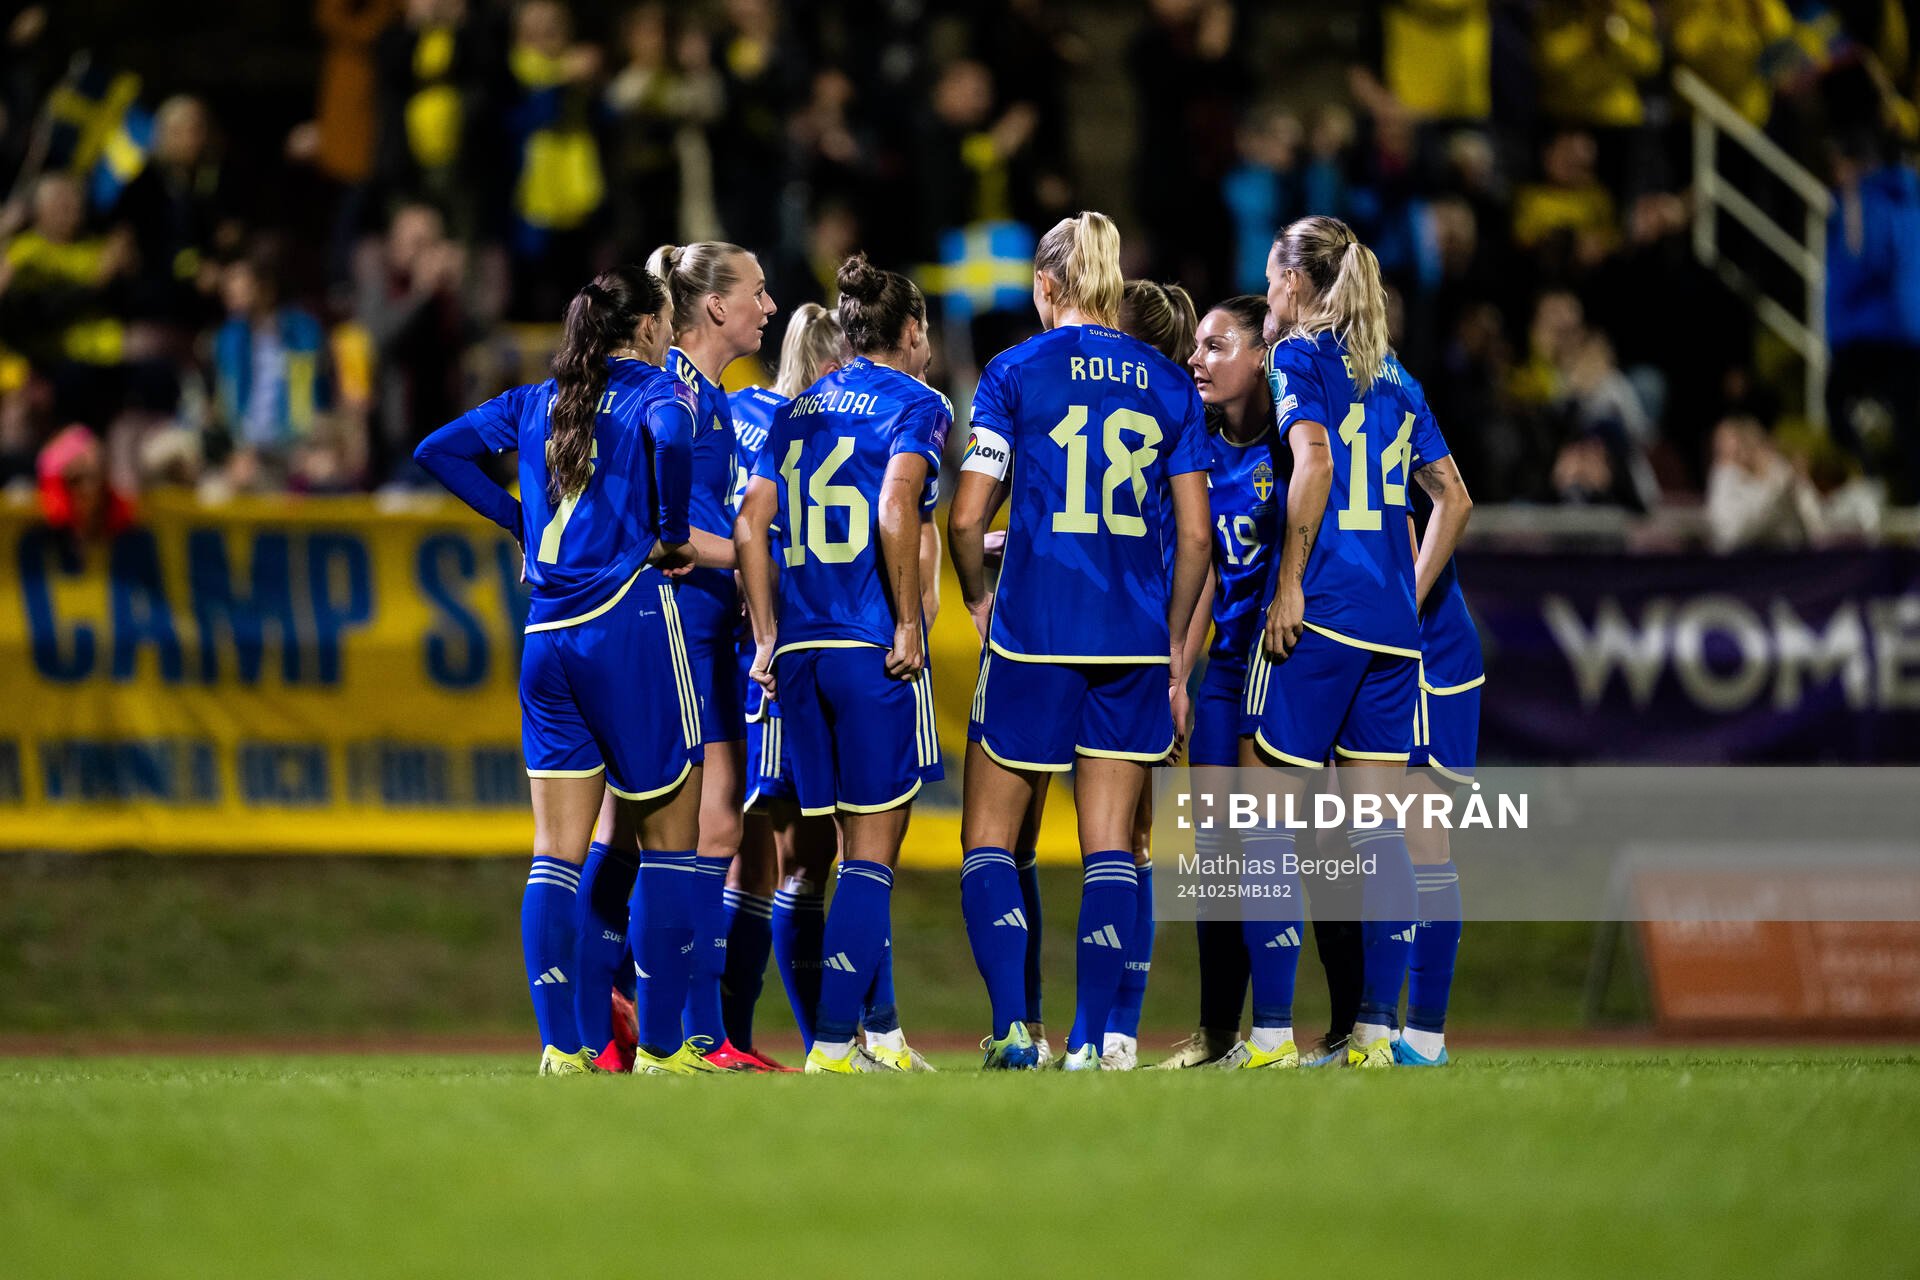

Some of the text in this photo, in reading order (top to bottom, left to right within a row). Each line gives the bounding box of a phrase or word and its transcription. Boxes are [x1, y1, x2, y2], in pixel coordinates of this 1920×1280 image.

[1070, 356, 1149, 390] ROLFÖ
[779, 436, 869, 569] 16
[975, 445, 1006, 463] LOVE
[1048, 405, 1164, 538] 18
[1338, 403, 1416, 531] 14
[1217, 514, 1262, 565] 19
[18, 526, 376, 685] CAMP
